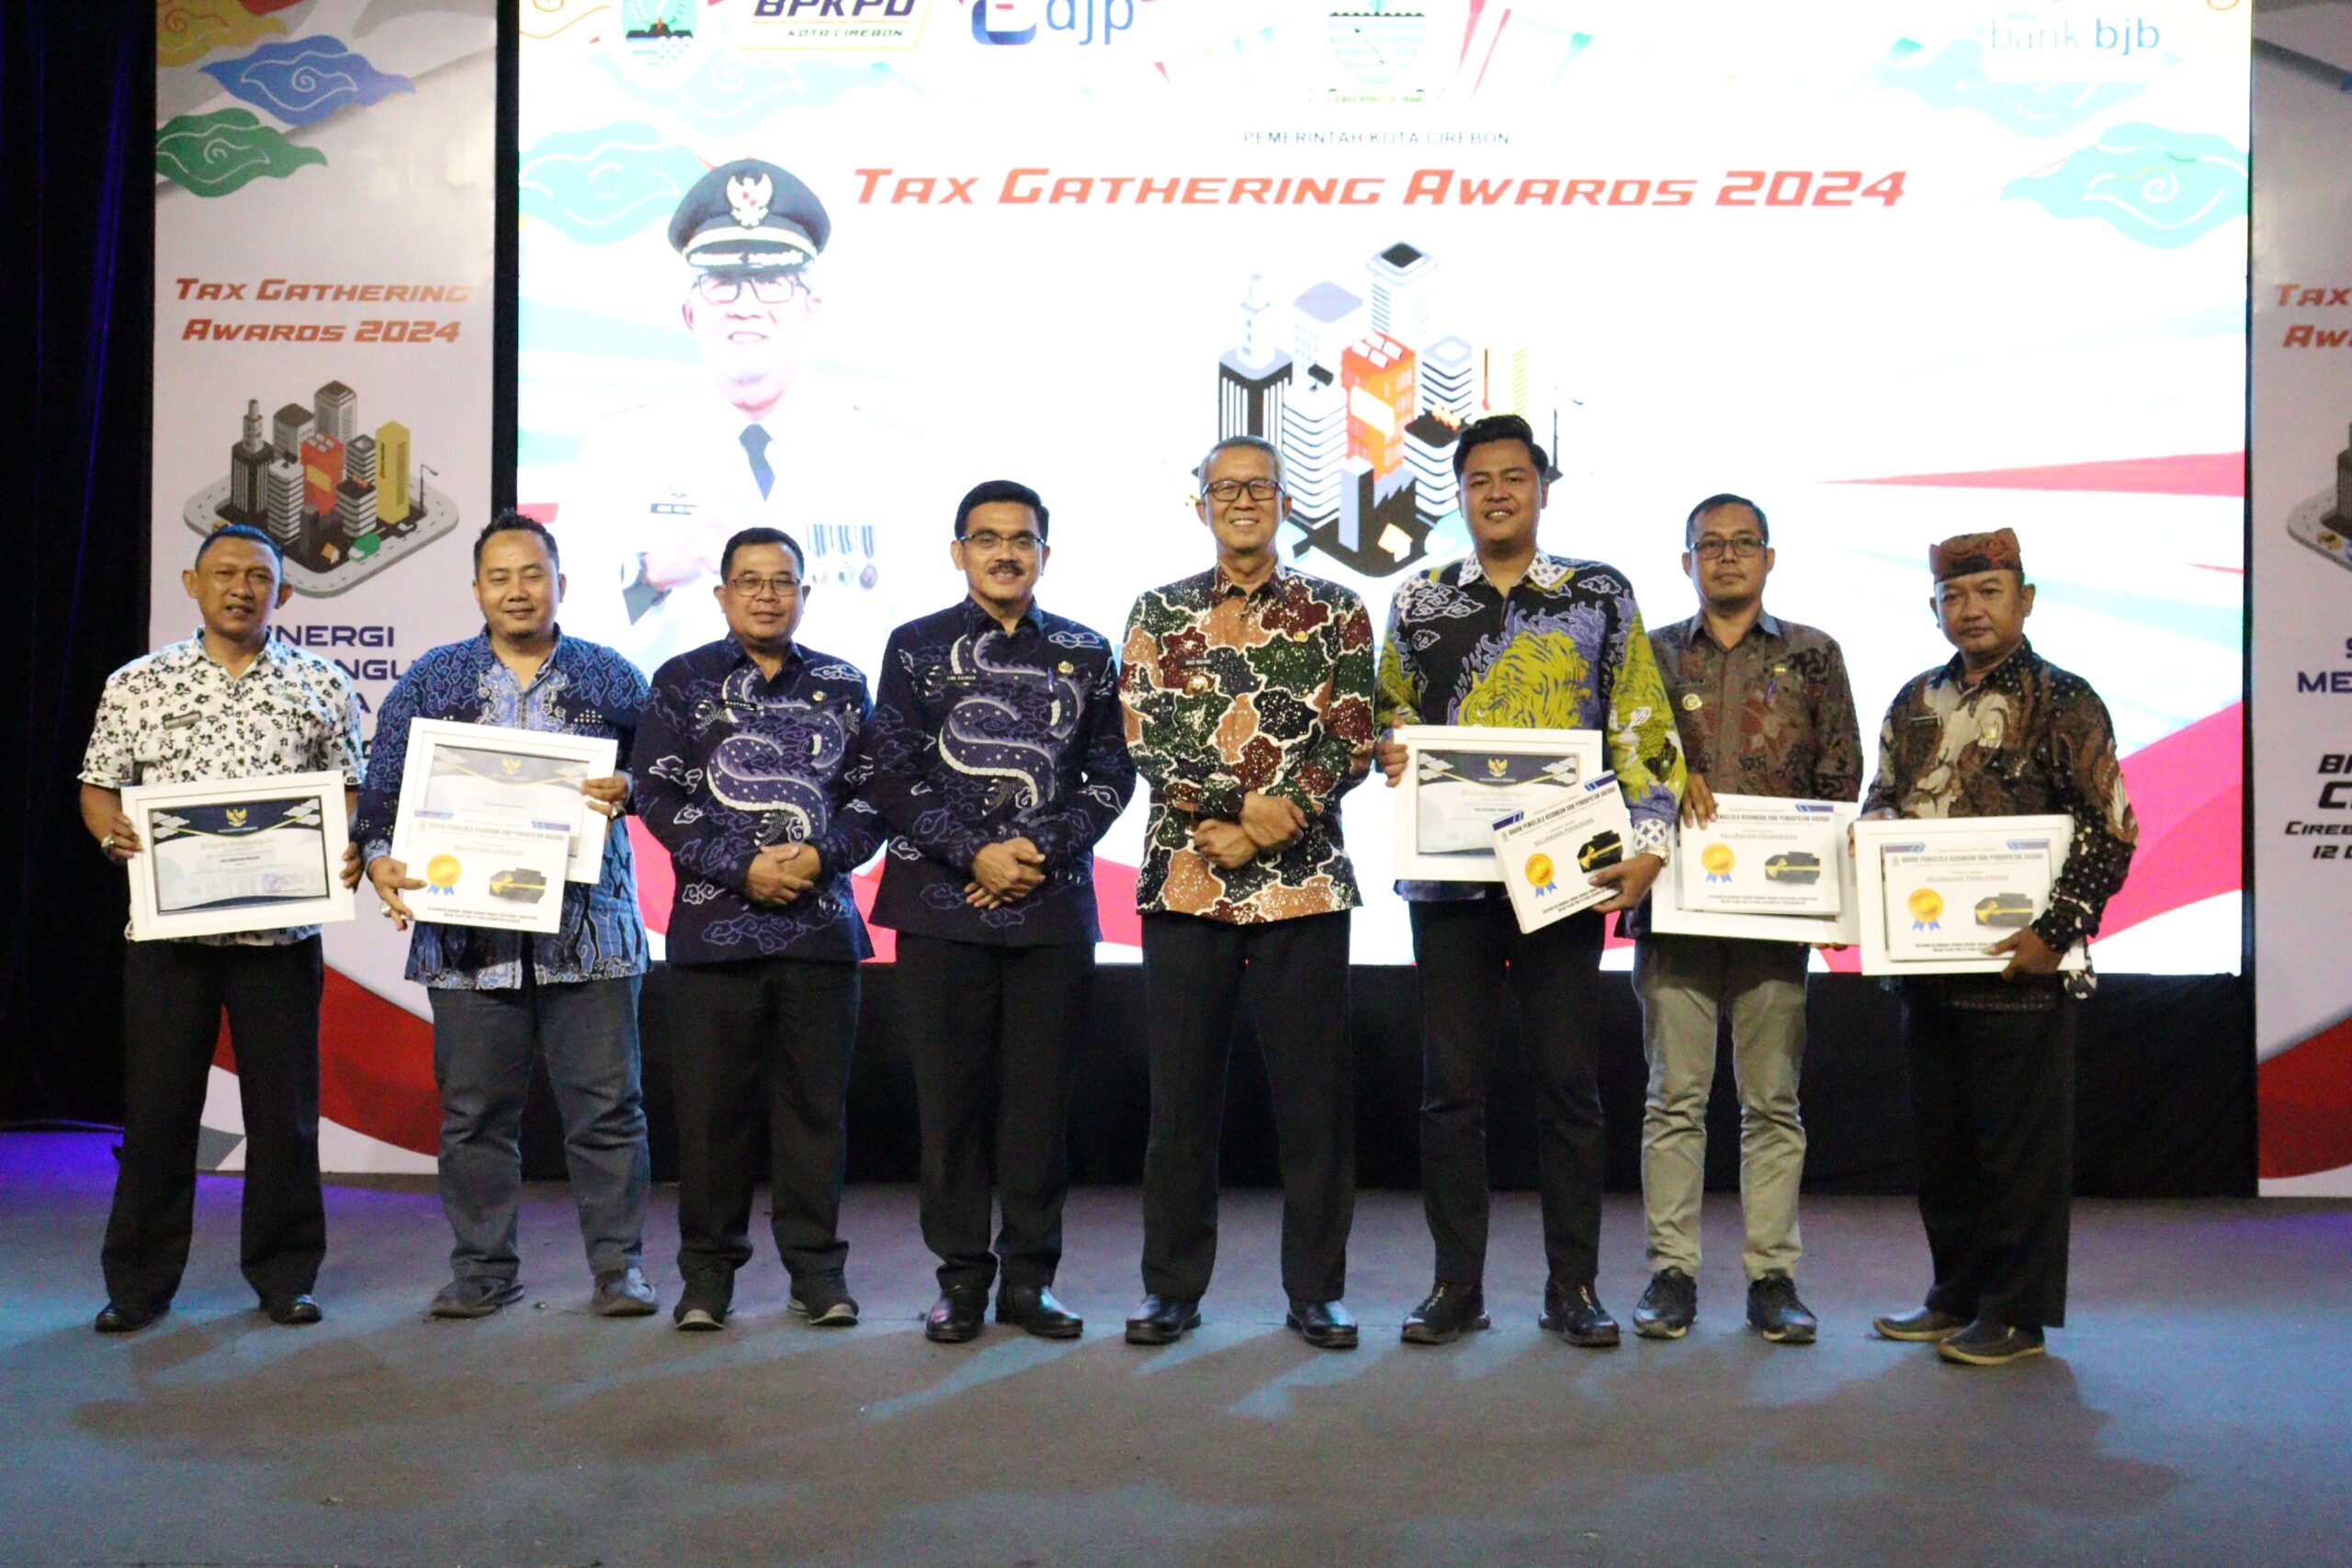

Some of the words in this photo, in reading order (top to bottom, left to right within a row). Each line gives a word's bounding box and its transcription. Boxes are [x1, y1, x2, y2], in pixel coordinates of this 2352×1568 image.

[787, 28, 830, 37] KOTA
[834, 28, 903, 37] CIREBON
[1991, 17, 2080, 50] bank
[2095, 17, 2159, 56] bjb
[1243, 130, 1363, 144] PEMERINTAH
[1370, 130, 1419, 144] KOTA
[1426, 130, 1510, 145] CIREBON
[1714, 171, 1907, 207] 2024
[354, 320, 462, 344] 2024
[2282, 324, 2352, 348] AW
[2297, 671, 2352, 693] ME
[2284, 820, 2352, 835] CIREB
[2312, 844, 2339, 860] 12
